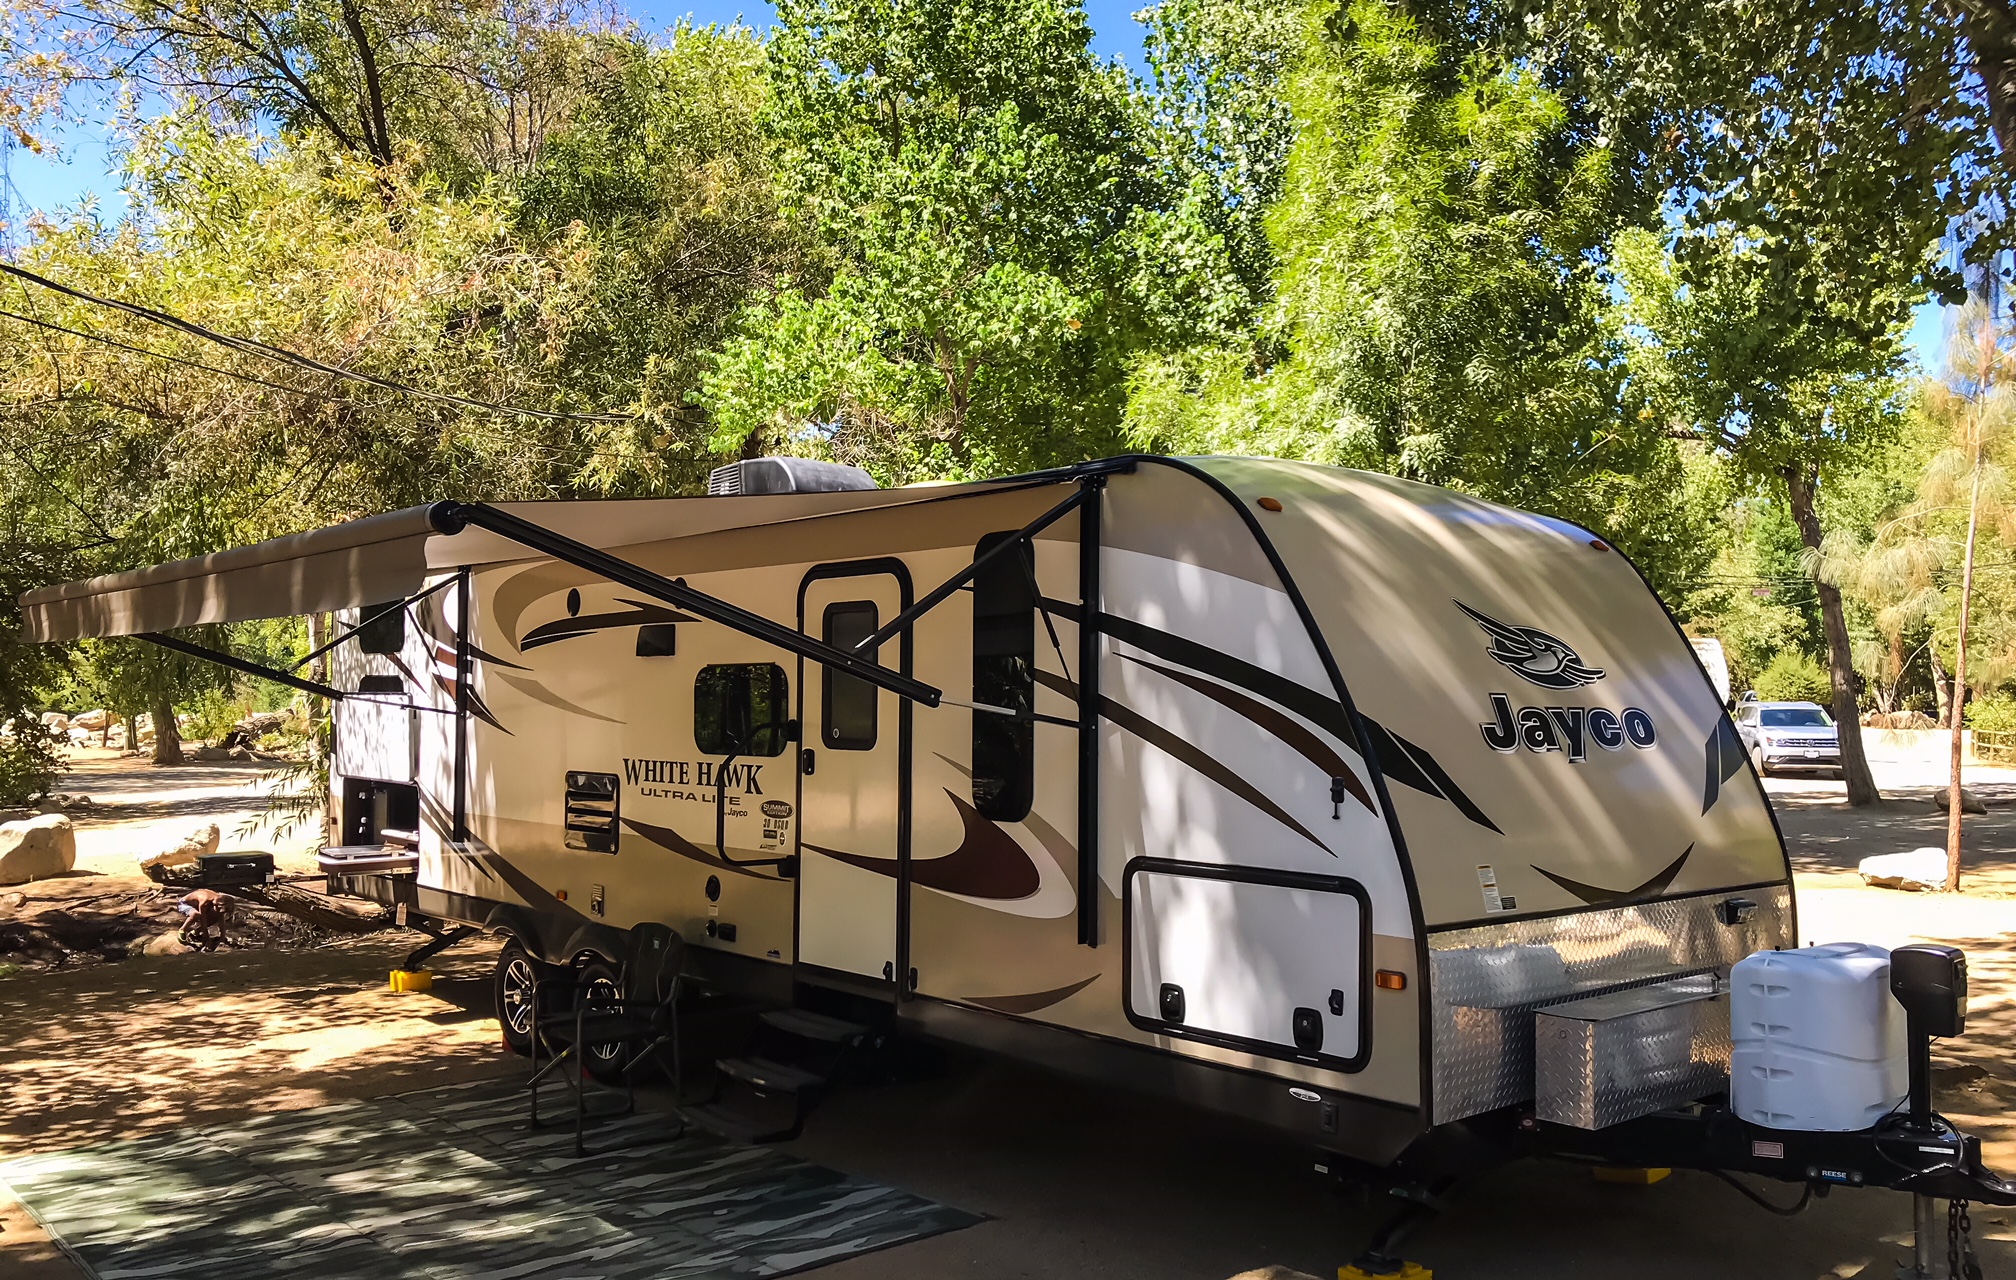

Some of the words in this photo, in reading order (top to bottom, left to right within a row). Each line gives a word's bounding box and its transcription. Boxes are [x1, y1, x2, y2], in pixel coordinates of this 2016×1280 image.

[1479, 693, 1658, 764] Jayco
[622, 758, 690, 786] WHITE
[640, 787, 698, 802] ULTRA
[702, 794, 741, 806] LIE
[727, 807, 748, 818] Jayco
[1821, 1169, 1847, 1179] REESE
